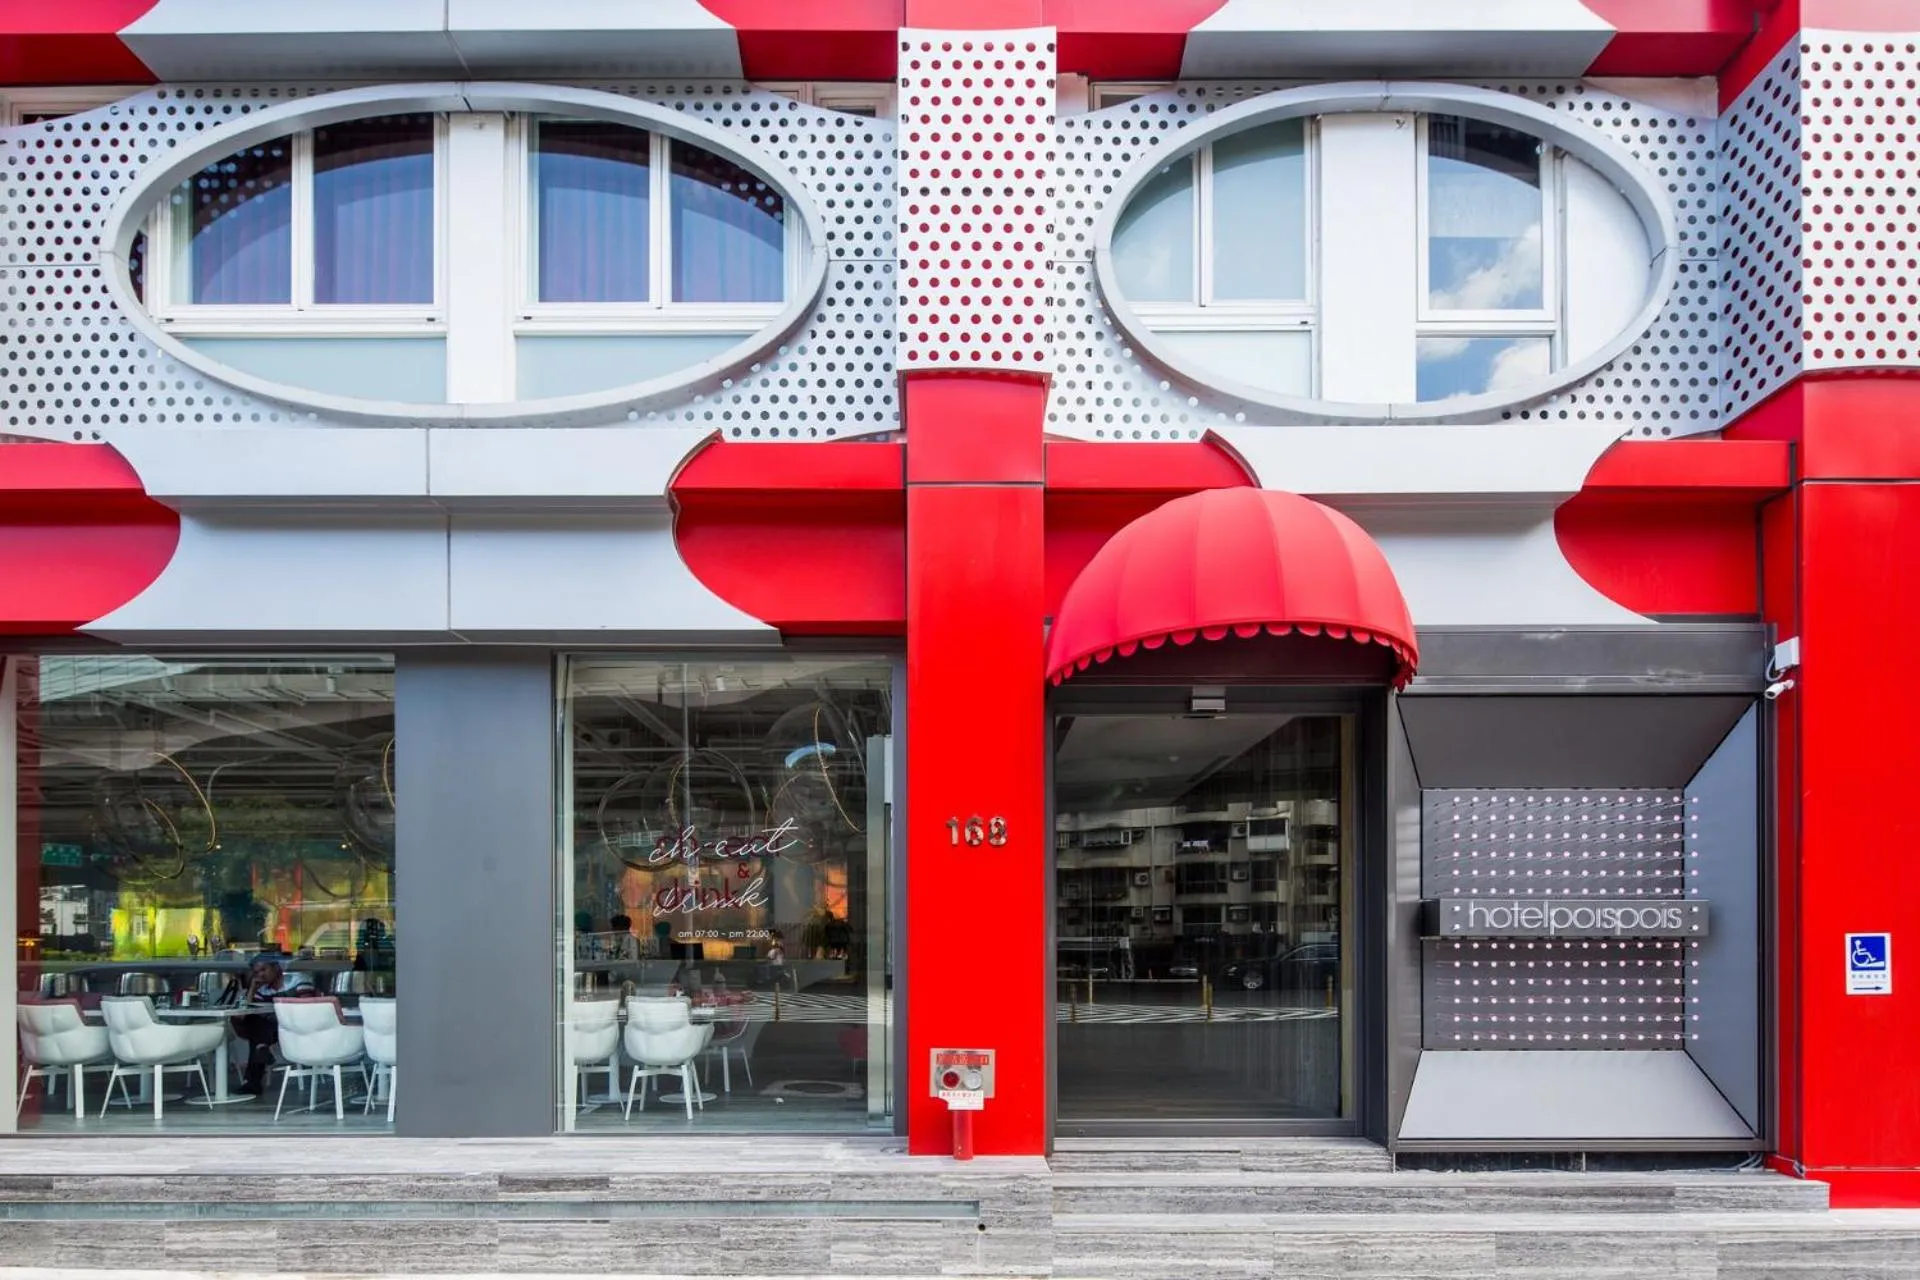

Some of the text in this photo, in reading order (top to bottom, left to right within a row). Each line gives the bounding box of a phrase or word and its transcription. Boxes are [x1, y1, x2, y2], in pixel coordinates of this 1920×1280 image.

[946, 816, 1008, 845] 168
[738, 862, 749, 878] &
[654, 878, 768, 917] drink
[1469, 901, 1682, 935] hotelpoispois
[695, 930, 719, 938] 07:00
[729, 931, 744, 940] pm
[746, 930, 769, 938] 22:00
